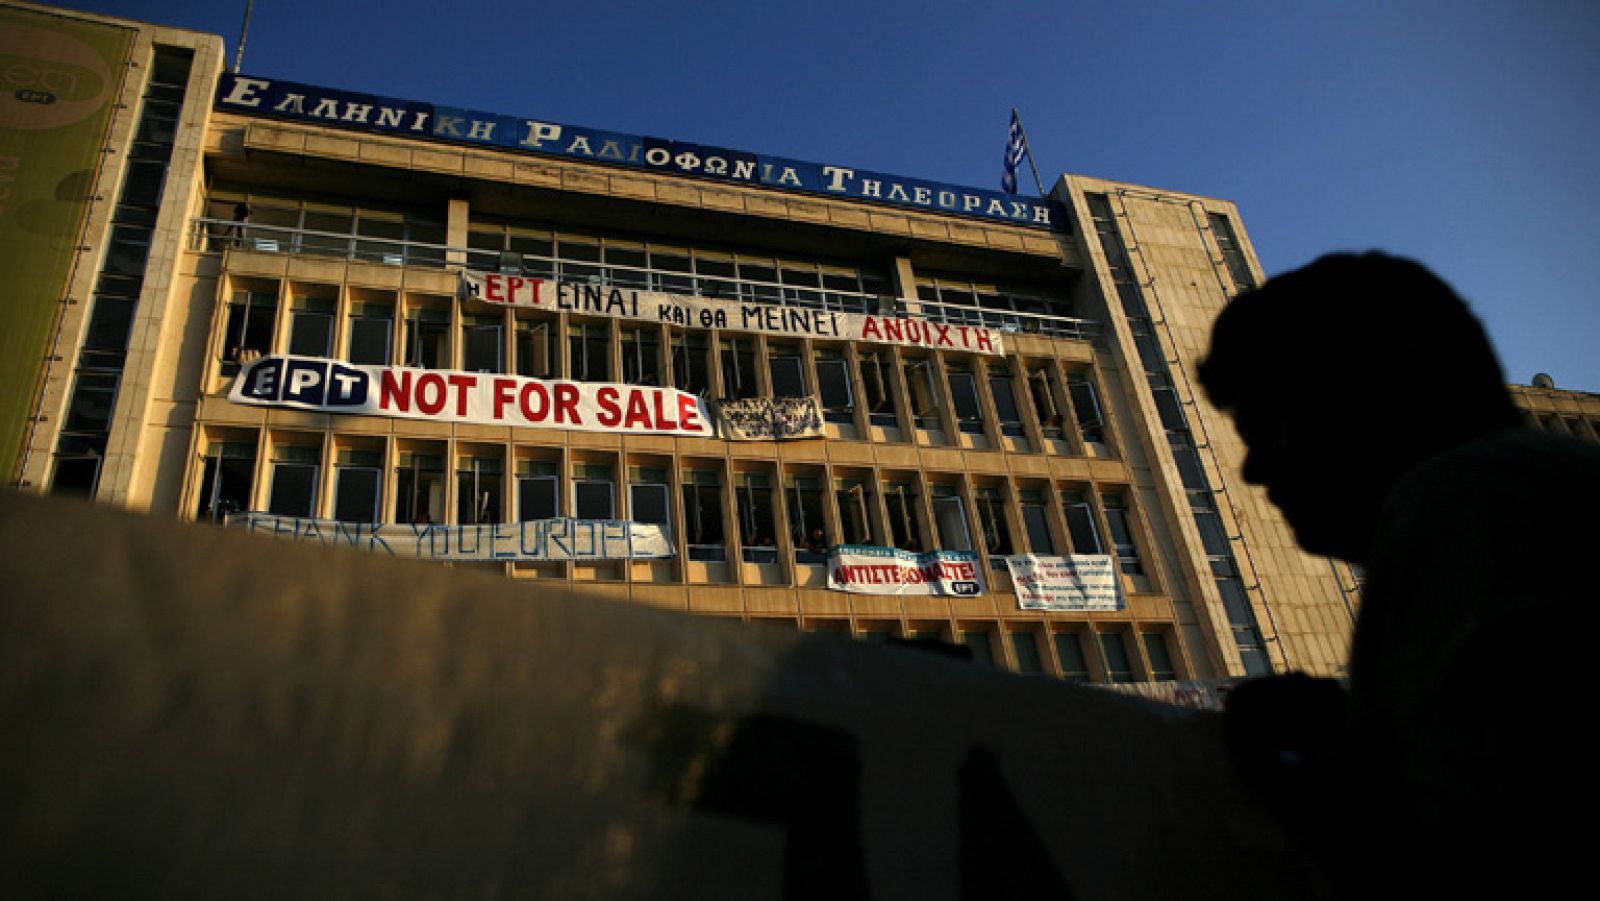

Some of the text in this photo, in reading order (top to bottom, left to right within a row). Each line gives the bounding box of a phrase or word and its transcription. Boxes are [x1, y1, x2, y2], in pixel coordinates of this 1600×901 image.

[222, 76, 1051, 224] ΕΛΛΗΝΙΚΗ ΡΑΔΙΟΦΩΝΙΑ ΤΗΛΕΟΡΑΣΗ
[484, 274, 545, 304] ΕΡΤ
[557, 282, 639, 316] ΕΙΝΑΙ
[658, 304, 691, 326] ΚΑΙ
[700, 308, 728, 328] ΘΑ
[741, 306, 839, 337] ΜΕΙΝΕΙ
[862, 315, 994, 352] ΑΝΟΙΧΤΗ
[379, 370, 478, 416] NOT
[493, 379, 582, 425] FOR
[596, 387, 703, 431] SALE
[410, 521, 482, 559] YOU
[489, 515, 656, 560] EUROPE
